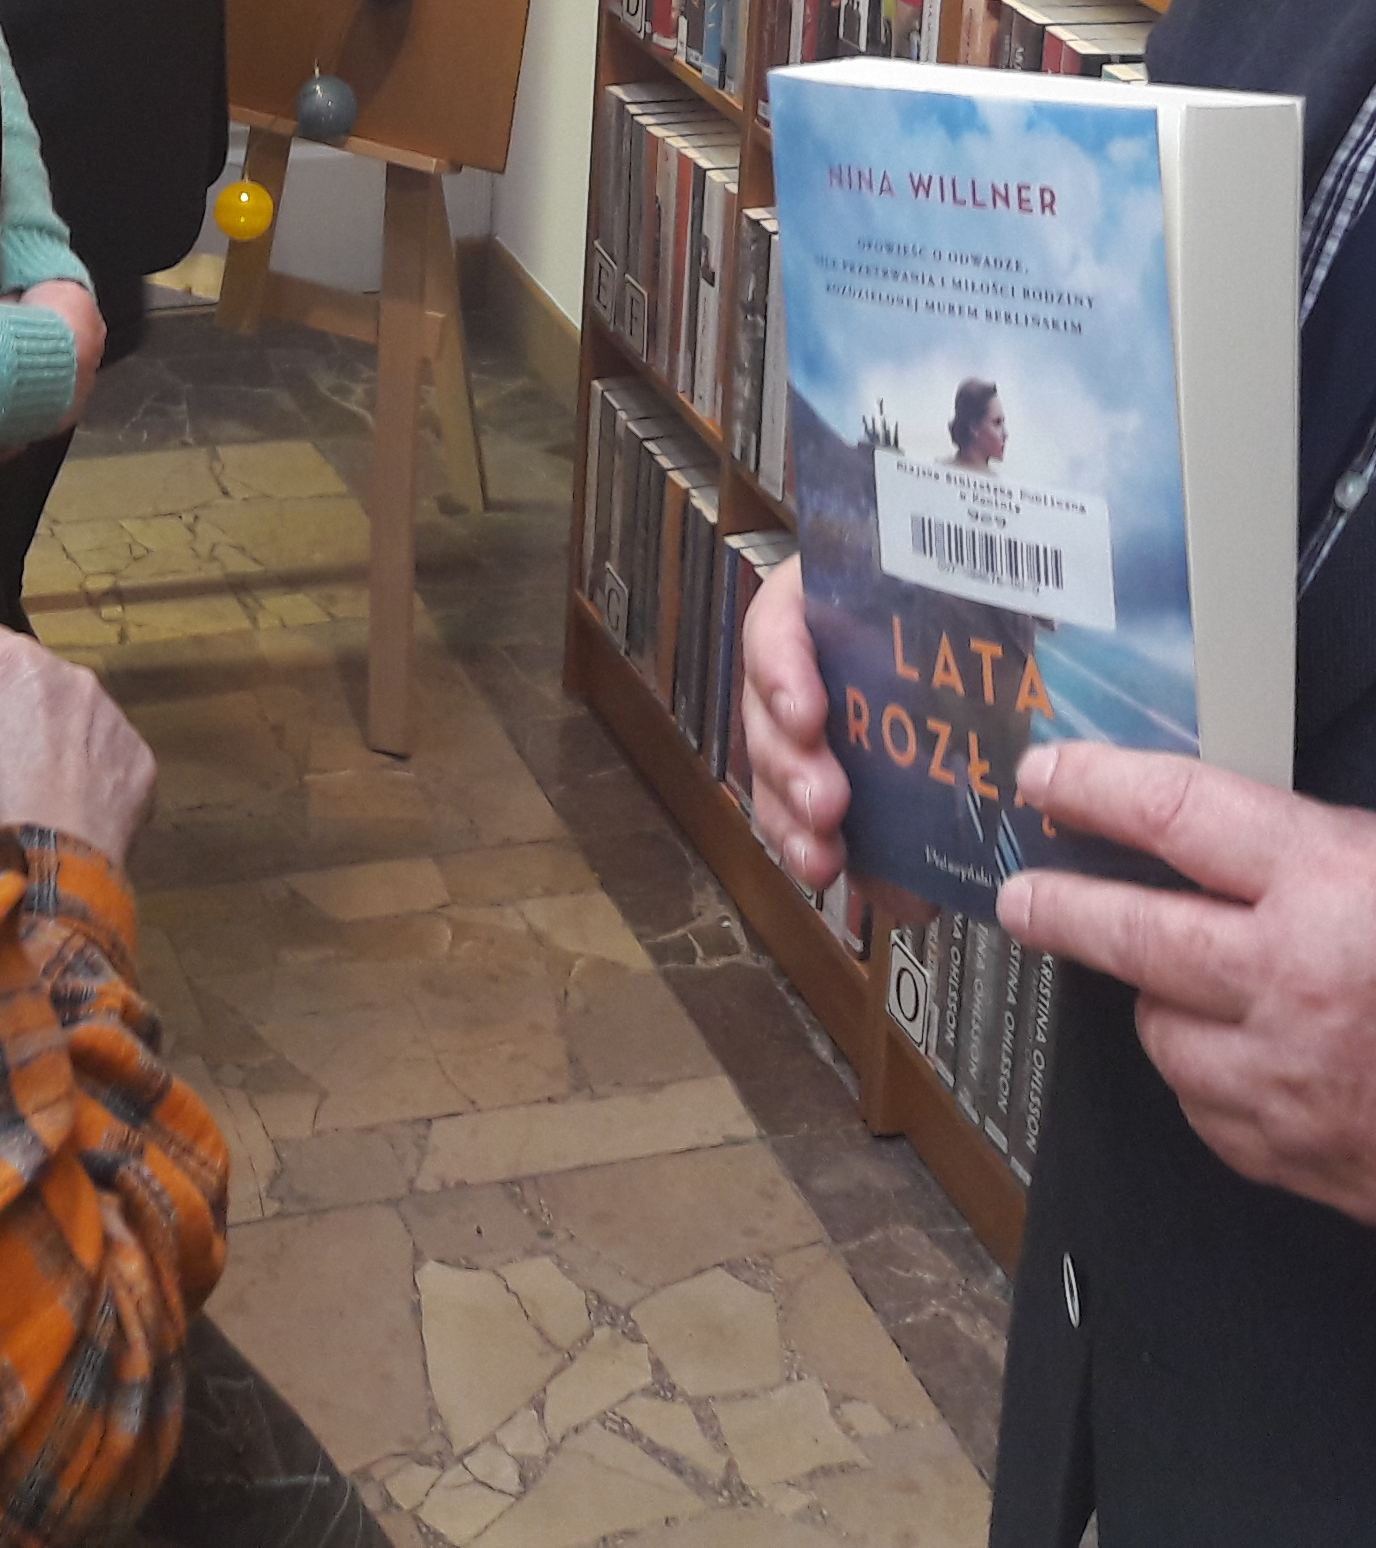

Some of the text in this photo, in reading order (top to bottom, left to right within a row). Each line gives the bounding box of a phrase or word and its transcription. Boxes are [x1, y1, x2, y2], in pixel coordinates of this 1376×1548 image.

[828, 162, 1058, 217] NINA WILLNER
[597, 260, 611, 313] E
[629, 295, 642, 339] F
[605, 586, 622, 628] G
[891, 613, 1056, 722] LATA
[895, 966, 920, 1022] O
[997, 1010, 1016, 1115] OHLSSON
[1025, 951, 1055, 1155] KRISTINA OHLSSON
